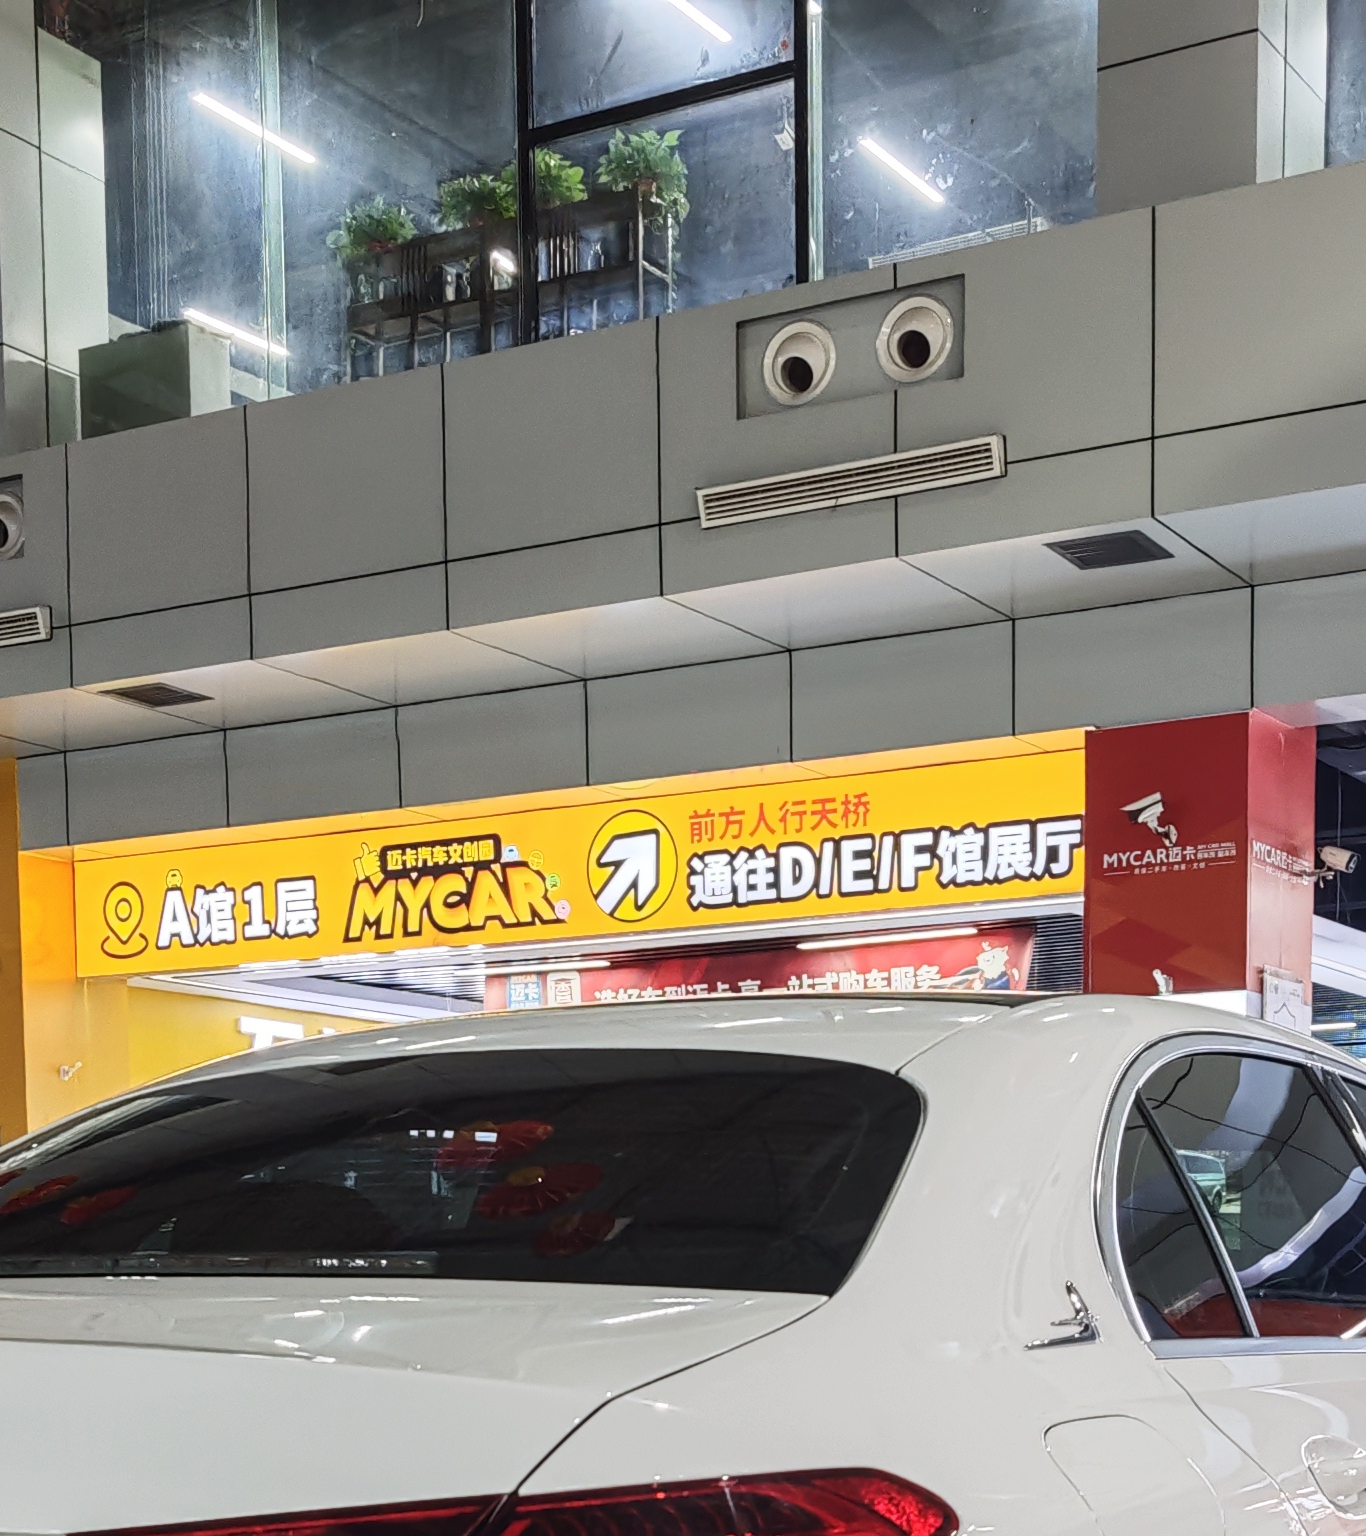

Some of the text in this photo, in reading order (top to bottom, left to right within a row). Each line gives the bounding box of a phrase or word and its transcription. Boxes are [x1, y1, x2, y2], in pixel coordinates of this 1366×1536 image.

[688, 792, 872, 841] 前方人行天桥
[386, 841, 495, 870] 迈卡汽车文创园
[687, 817, 1084, 908] 通往D/E/F馆展厅
[156, 876, 319, 950] A馆1层
[346, 867, 562, 942] MYCAR
